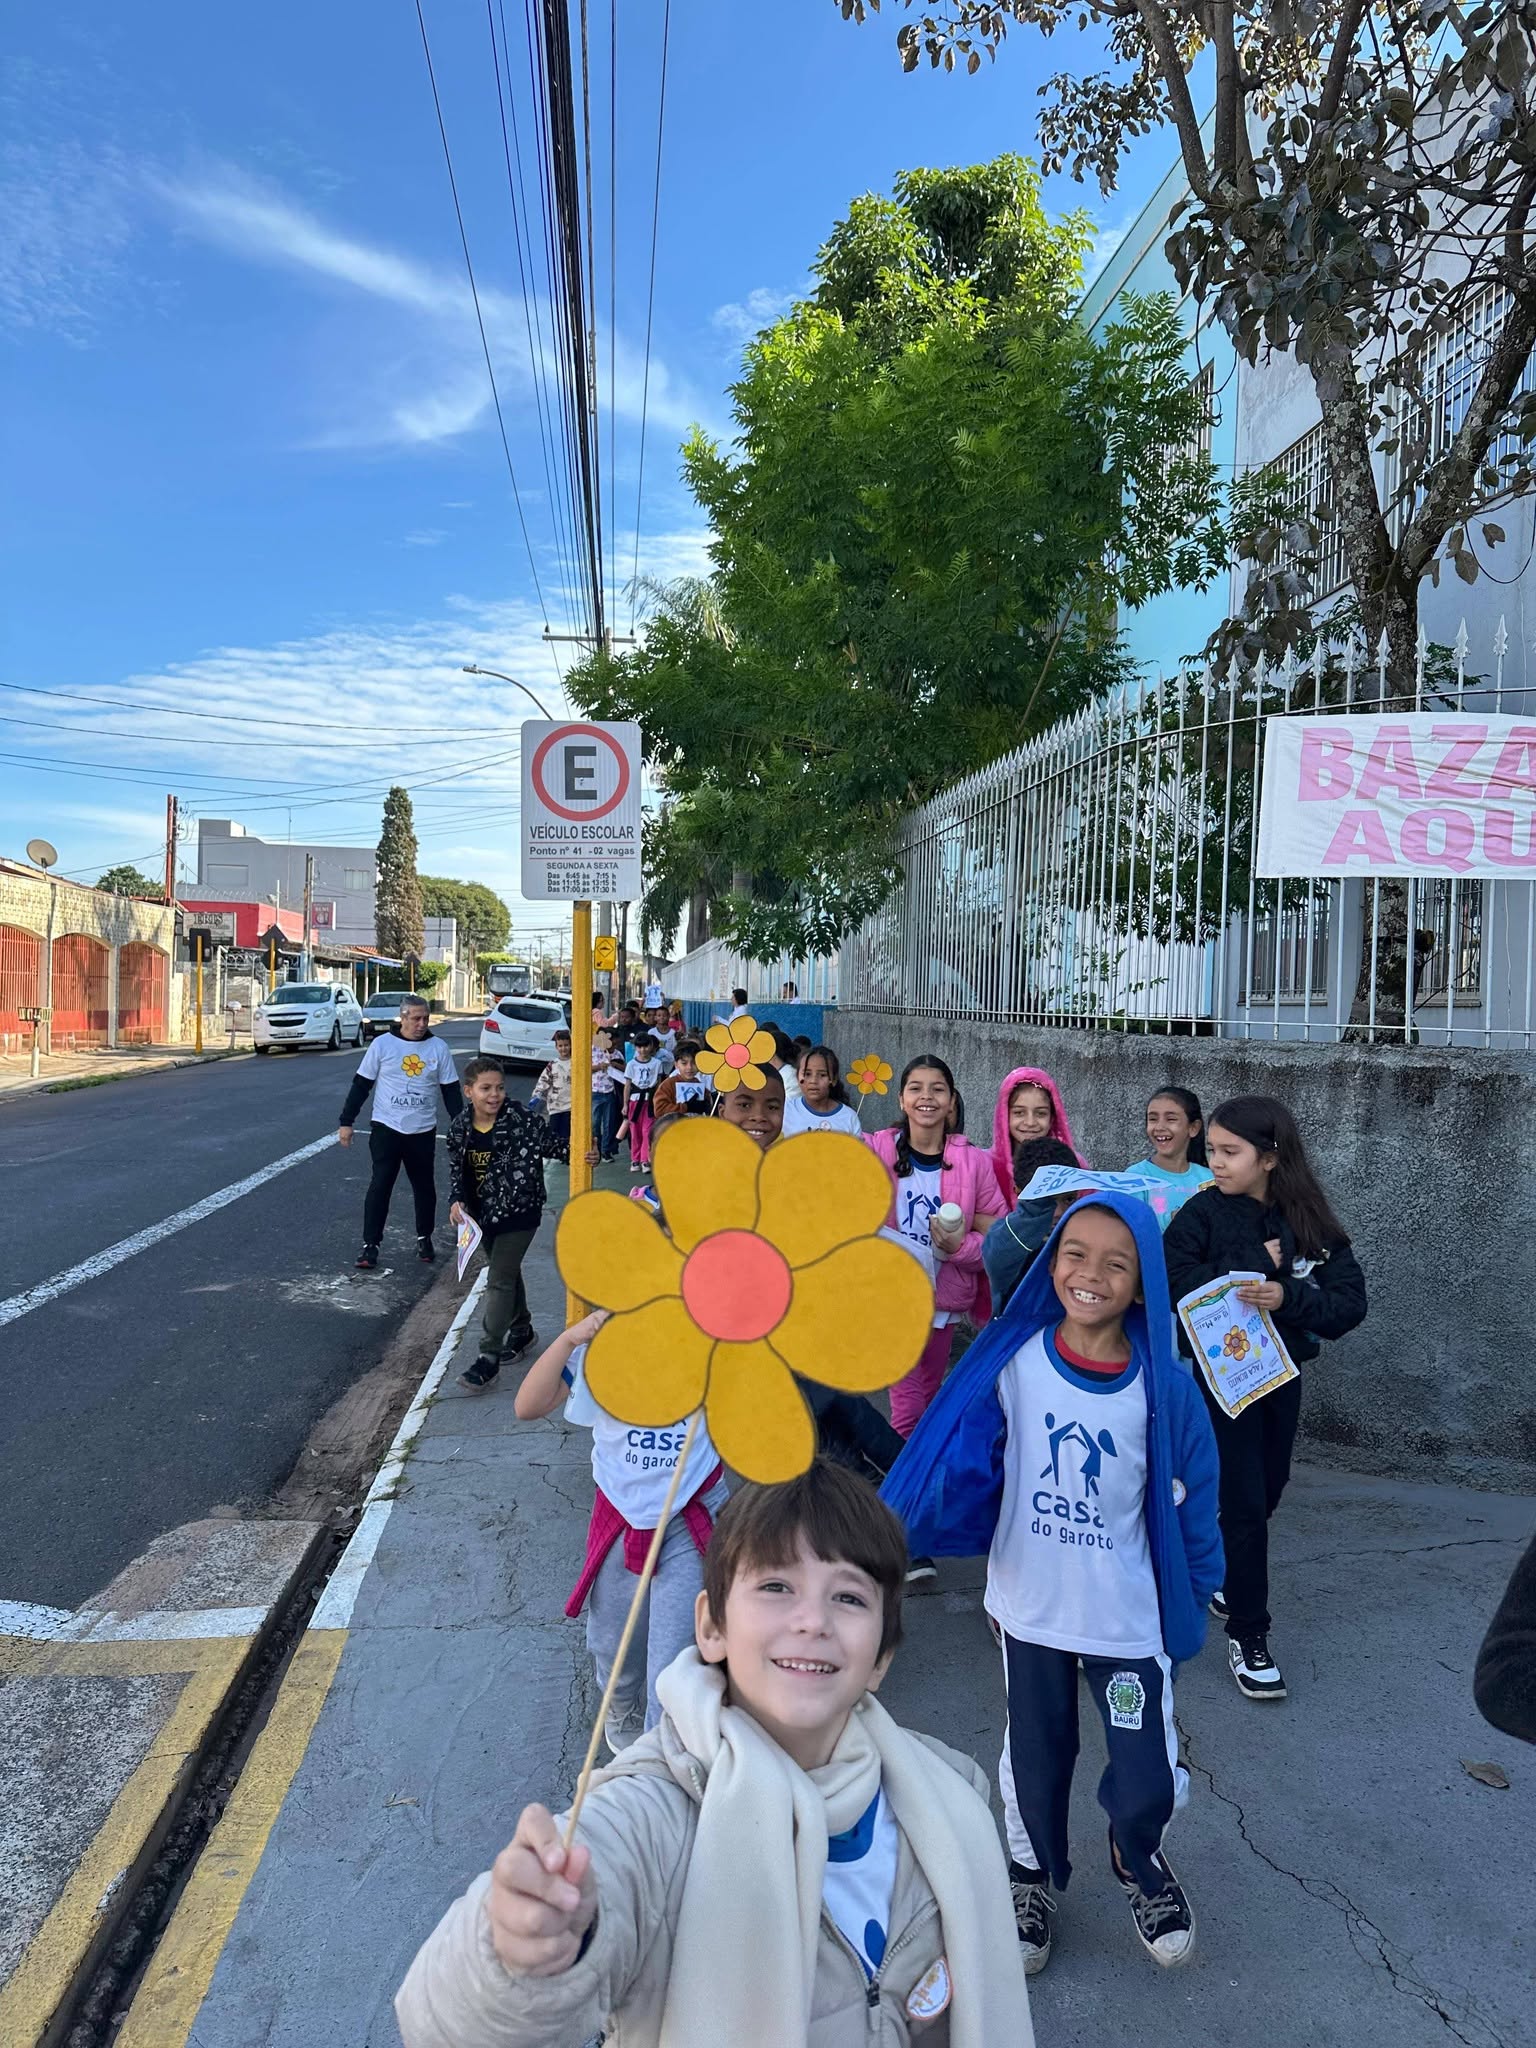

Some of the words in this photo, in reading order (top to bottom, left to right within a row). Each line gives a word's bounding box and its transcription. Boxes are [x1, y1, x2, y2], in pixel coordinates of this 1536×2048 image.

[564, 746, 598, 800] E
[1297, 724, 1536, 802] BAZA
[530, 822, 578, 839] VEÍCULO
[581, 825, 634, 839] ESCOLAR
[529, 846, 557, 855] Ponto
[572, 846, 582, 855] 41
[607, 847, 635, 857] vagas
[546, 862, 585, 870] SEGUNDA
[586, 862, 592, 870] A
[593, 862, 619, 870] SEXTA
[627, 1429, 687, 1451] casa
[625, 1449, 638, 1464] do
[642, 1455, 680, 1470] garo
[1031, 1517, 1051, 1536] do
[1059, 1526, 1114, 1550] garoto
[1114, 1715, 1140, 1726] BAURU
